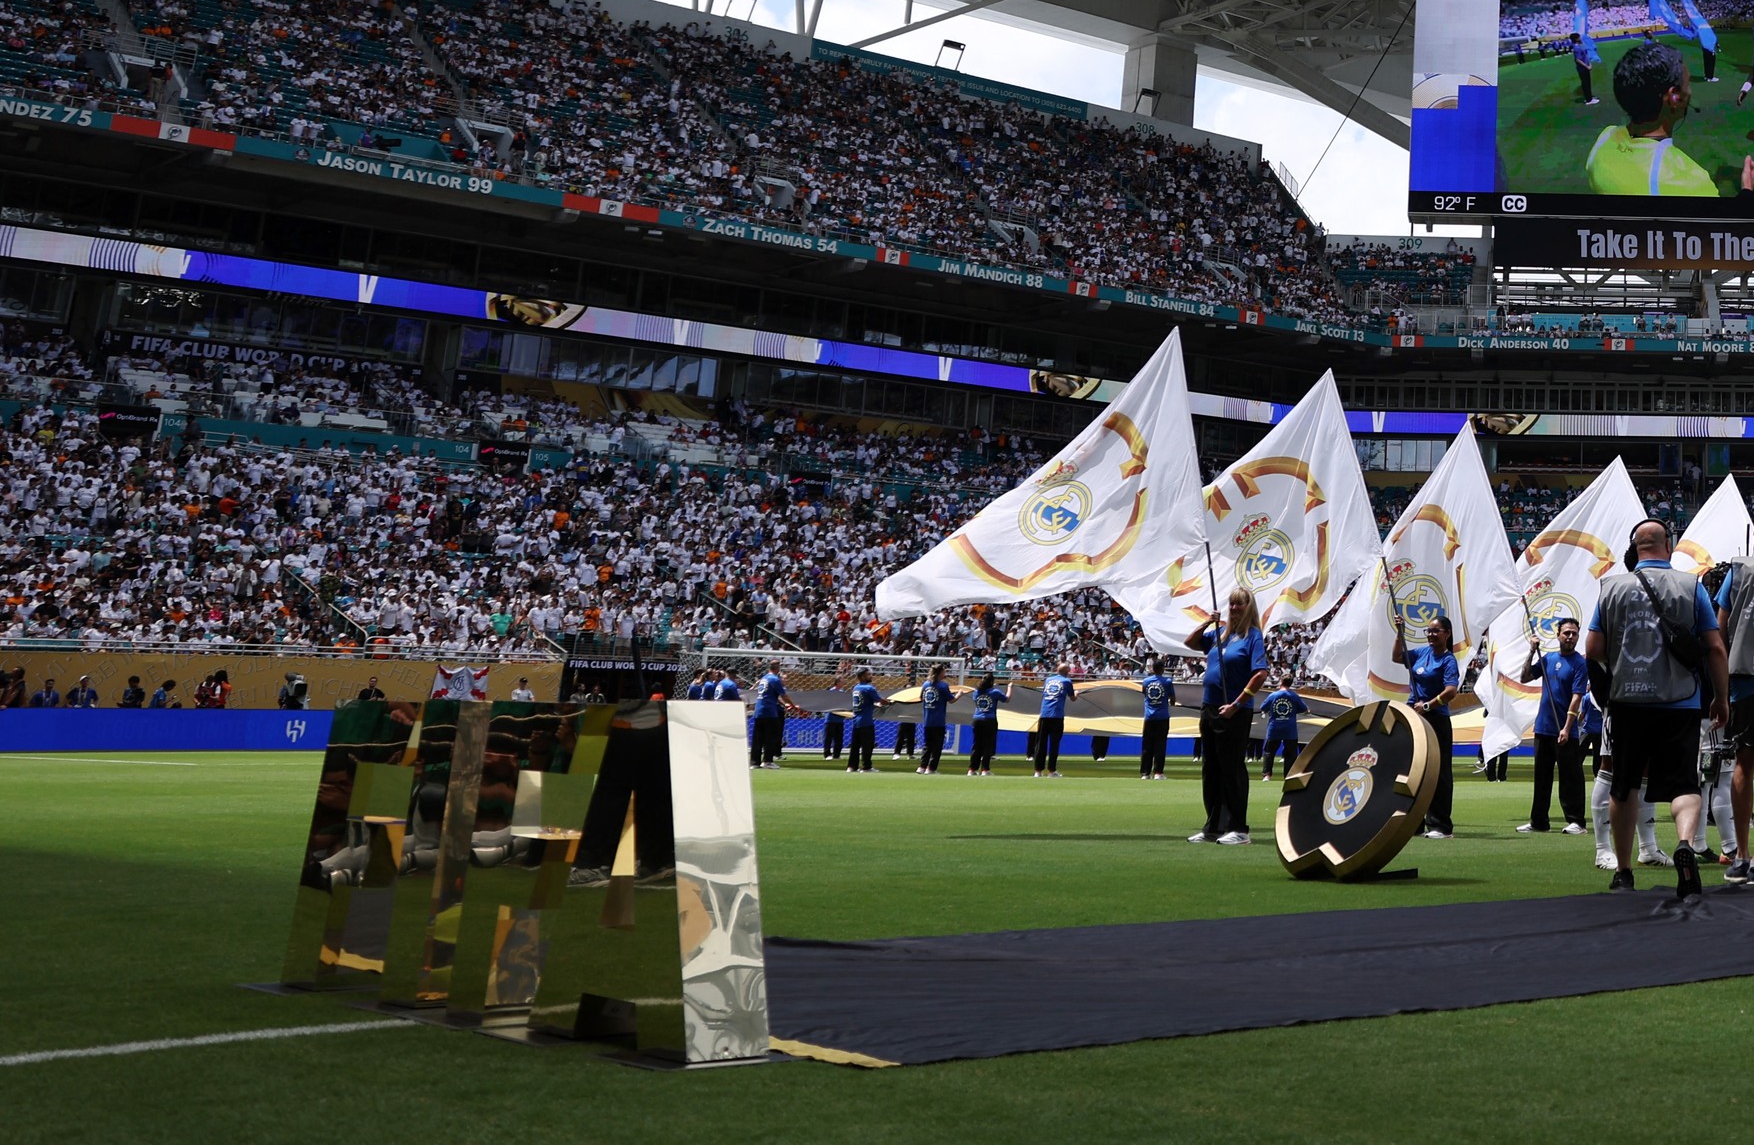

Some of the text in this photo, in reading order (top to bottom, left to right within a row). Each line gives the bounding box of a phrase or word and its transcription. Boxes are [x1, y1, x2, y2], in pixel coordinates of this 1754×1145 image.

[60, 106, 93, 128] 75
[316, 151, 493, 195] JASON TAYLOR 99
[1466, 196, 1477, 211] F
[1503, 196, 1526, 211] CC
[702, 218, 838, 255] ZACH THOMAS 54
[1399, 237, 1423, 250] 309
[1576, 228, 1639, 259] Take
[1646, 230, 1664, 260] It
[1672, 230, 1702, 261] To
[937, 258, 1043, 289] JIM MANDICH 88
[1125, 291, 1216, 318] BILL STANFILL 84
[1320, 324, 1351, 342] SCOTT
[1352, 329, 1365, 343] 13
[130, 334, 173, 355] FIFA
[178, 339, 230, 362] CLUB
[1457, 336, 1570, 352] DICK ANDERSON 40
[1676, 340, 1698, 353] NAT
[1701, 340, 1745, 355] MOORE
[164, 417, 181, 429] 104
[454, 444, 470, 455] 104
[535, 452, 550, 463] 105
[569, 659, 588, 670] FIFA
[590, 659, 612, 671] CLUB
[647, 662, 665, 673] CUP
